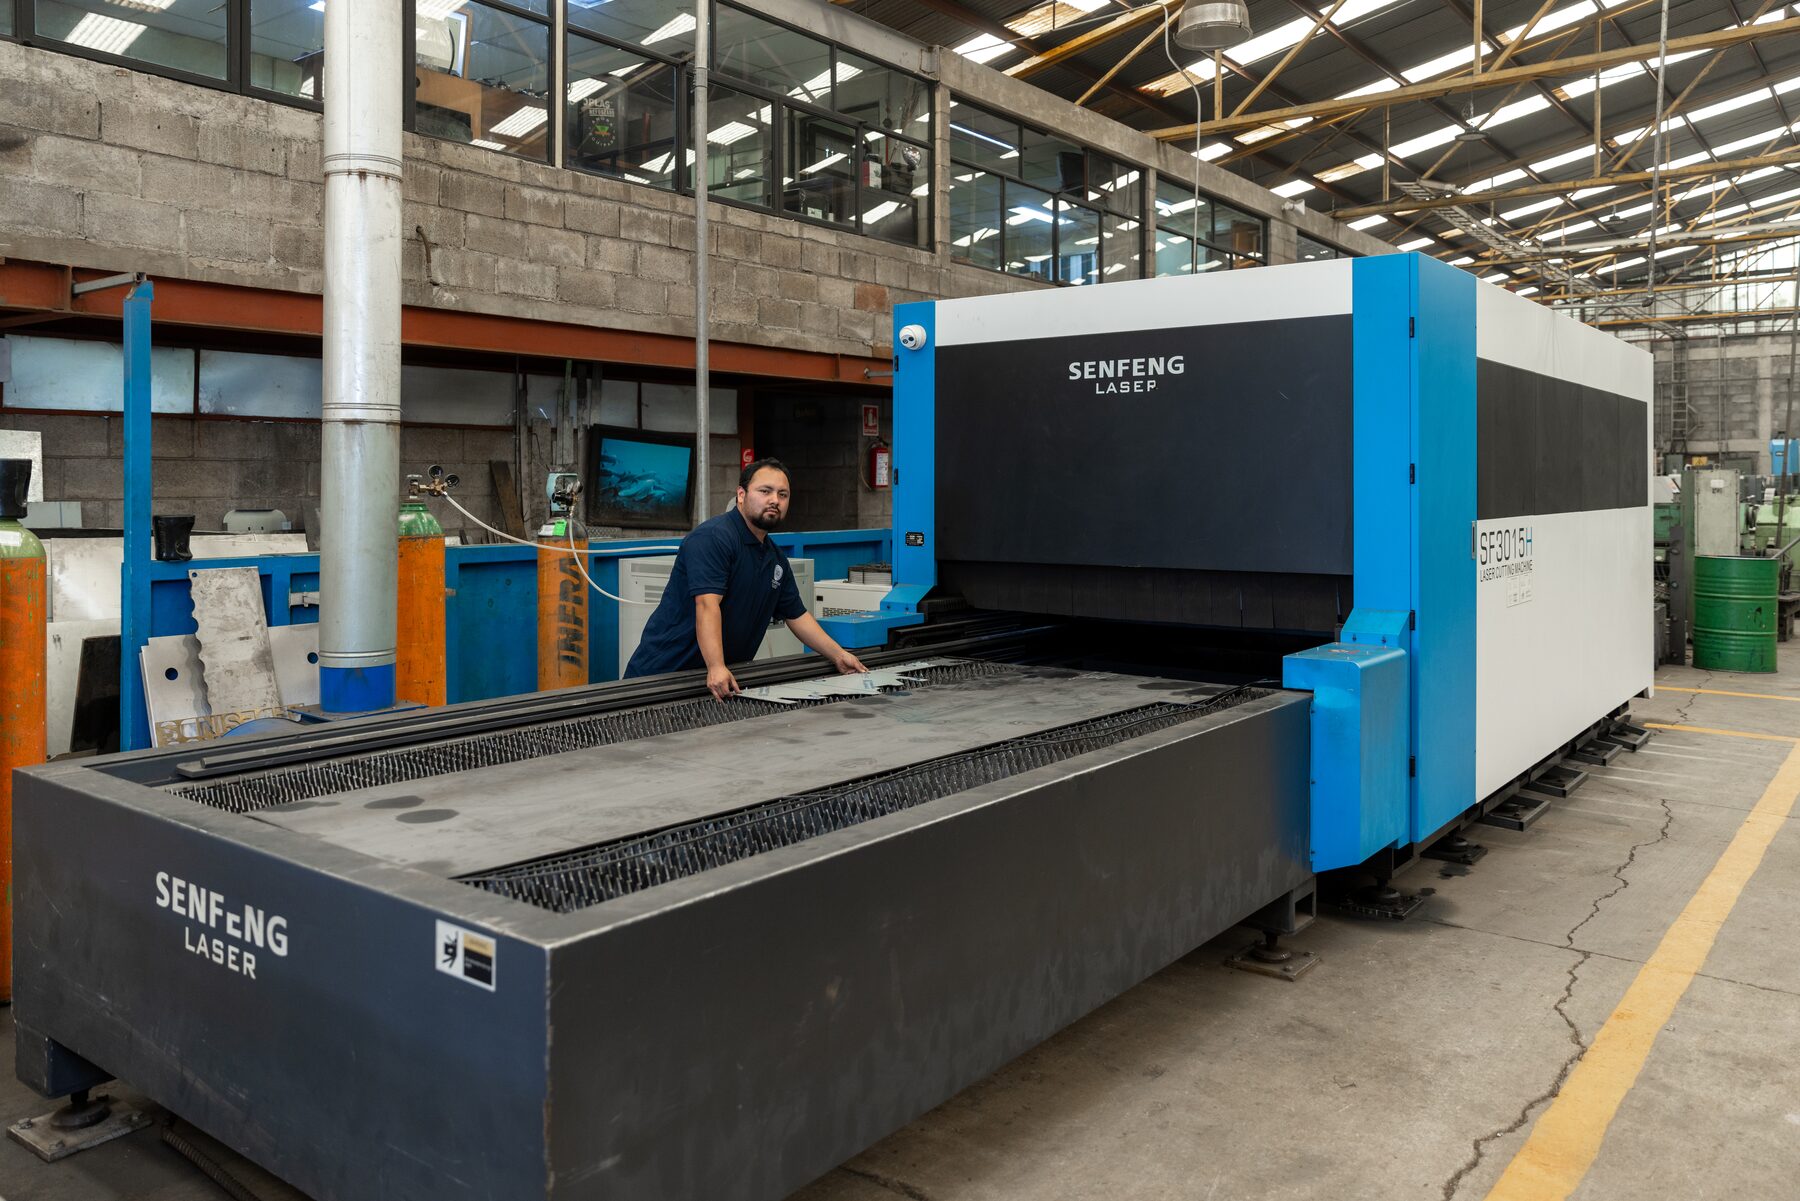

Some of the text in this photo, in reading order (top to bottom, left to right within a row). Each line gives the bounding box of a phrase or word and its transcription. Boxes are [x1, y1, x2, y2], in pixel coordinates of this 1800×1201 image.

[1069, 355, 1185, 380] SENFENG
[1096, 380, 1157, 394] LASER
[1480, 526, 1533, 565] SF3015H
[1480, 567, 1495, 582] LASER
[558, 557, 584, 675] INFRA
[156, 871, 288, 957] SENFENG
[185, 926, 256, 980] LASER
